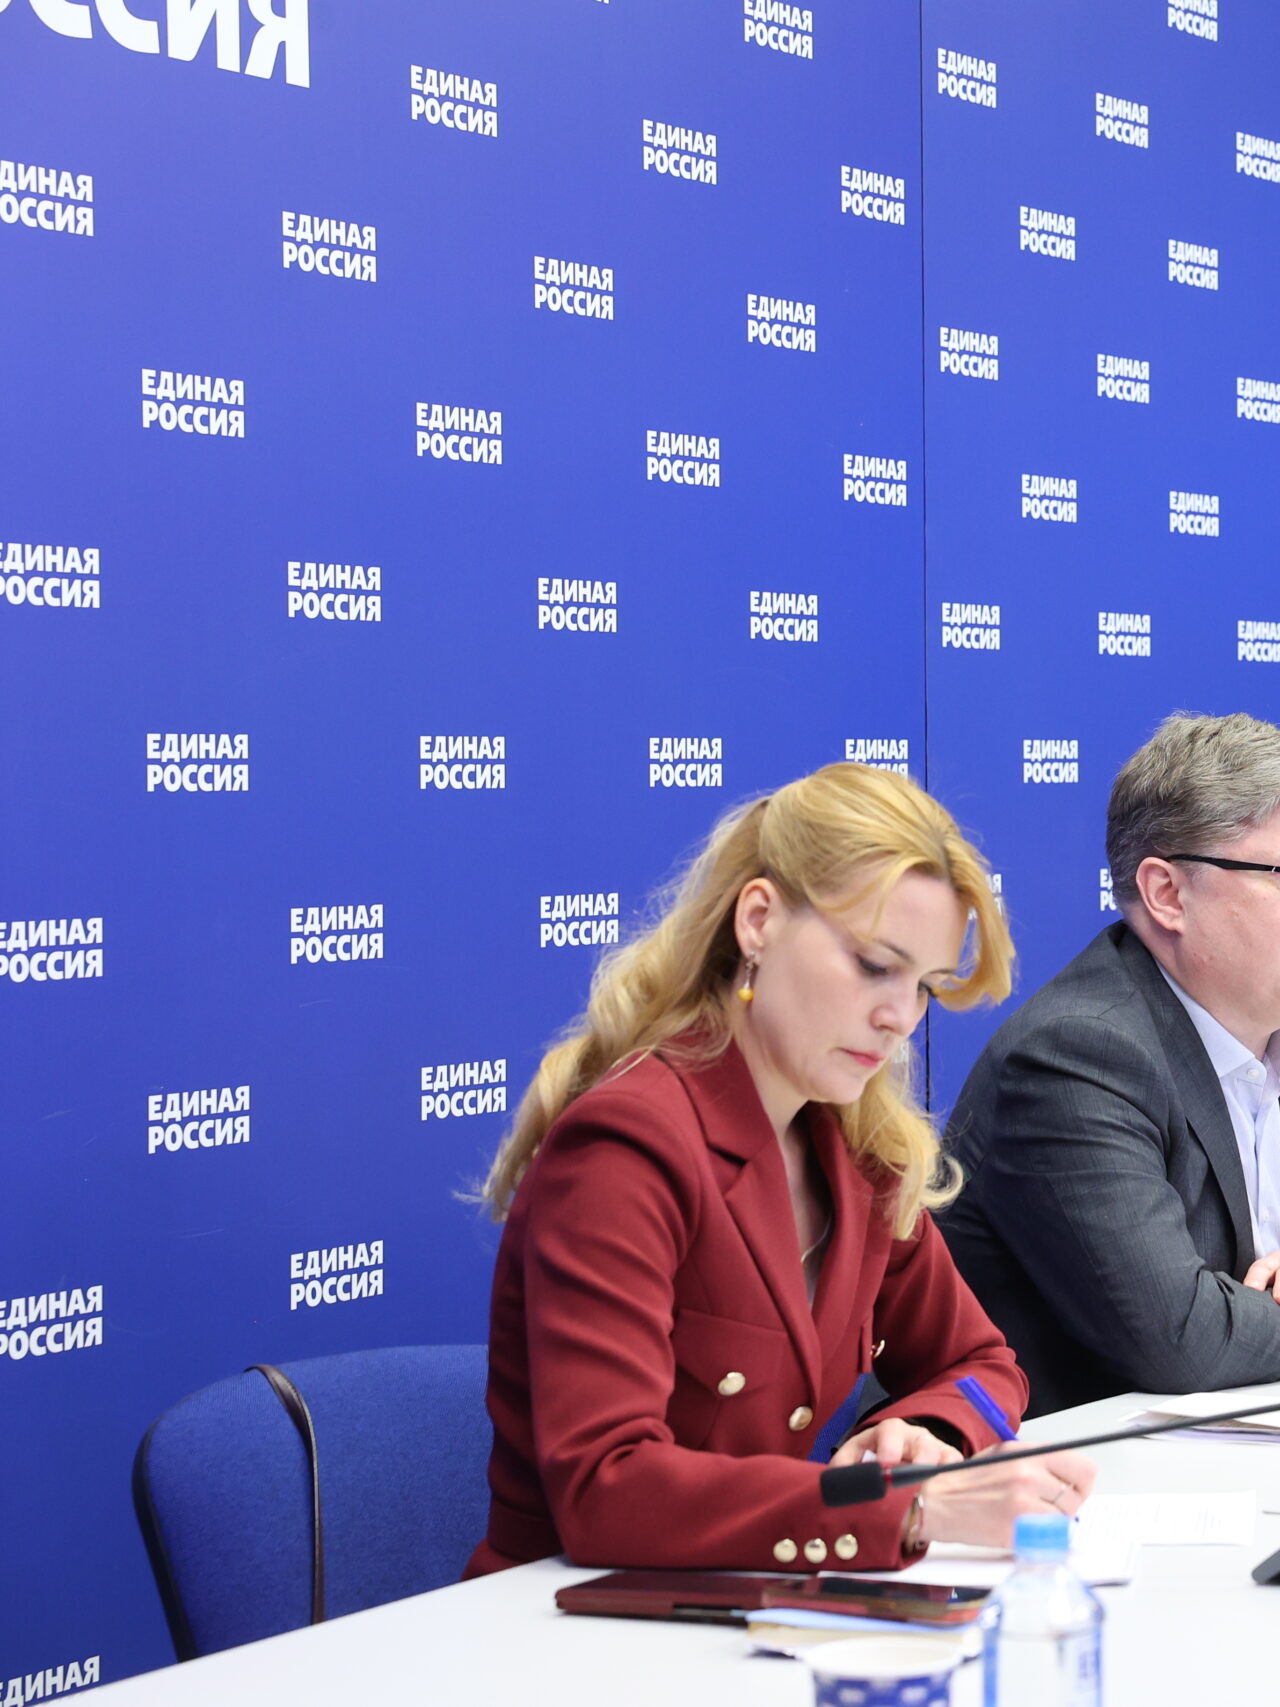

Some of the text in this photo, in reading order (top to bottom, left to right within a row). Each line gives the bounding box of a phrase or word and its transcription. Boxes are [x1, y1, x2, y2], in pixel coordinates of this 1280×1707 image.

[744, 0, 813, 33] ЕДИНАЯ
[1168, 6, 1218, 42] РОССИЯ
[744, 18, 813, 60] РОССИЯ
[938, 48, 996, 83] ЕДИНАЯ
[411, 65, 497, 107] ЕДИНАЯ
[938, 72, 996, 108] РОССИЯ
[411, 94, 497, 137] РОССИЯ
[1096, 93, 1148, 125] ЕДИНАЯ
[643, 119, 716, 157] ЕДИНАЯ
[1096, 115, 1148, 148] РОССИЯ
[644, 146, 716, 184] РОССИЯ
[0, 160, 93, 202] ДИНАЯ
[841, 166, 904, 199] ЕДИНАЯ
[0, 194, 93, 236] ОССИЯ
[842, 190, 904, 225] РОССИЯ
[1020, 206, 1075, 236] ЕДИНАЯ
[282, 211, 376, 251] ЕДИНАЯ
[1020, 229, 1075, 260] РОССИЯ
[283, 241, 376, 282] РОССИЯ
[1169, 240, 1218, 268] ЕДИНАЯ
[534, 256, 613, 291] ЕДИНАЯ
[1169, 261, 1218, 290] РОССИЯ
[535, 284, 613, 320] РОССИЯ
[748, 294, 815, 325] ЕДИНАЯ
[748, 320, 815, 352] РОССИЯ
[940, 327, 998, 355] ЕДИНАЯ
[940, 351, 998, 380] РОССИЯ
[1097, 354, 1149, 380] ЕДИНАЯ
[142, 369, 244, 405] ЕДИНАЯ
[1097, 376, 1149, 403] РОССИЯ
[142, 400, 244, 438] РОССИЯ
[416, 402, 501, 435] ЕДИНАЯ
[417, 431, 502, 464] РОССИЯ
[647, 430, 719, 459] ЕДИНАЯ
[647, 457, 719, 487] РОССИЯ
[844, 454, 906, 481] ЕДИНАЯ
[844, 478, 906, 506] РОССИЯ
[1022, 474, 1077, 499] ЕДИНАЯ
[1022, 497, 1077, 522] РОССИЯ
[1170, 491, 1219, 514] ЕДИНАЯ
[1170, 513, 1219, 536] РОССИЯ
[288, 562, 380, 590] ЕДИНАЯ
[538, 578, 616, 604] ЕДИНАЯ
[288, 591, 381, 621] РОССИЯ
[539, 605, 616, 632] РОССИЯ
[750, 591, 817, 616] ЕДИНАЯ
[942, 603, 1000, 626] ЕДИНАЯ
[751, 616, 818, 642] РОССИЯ
[942, 626, 1000, 649] РОССИЯ
[1099, 612, 1150, 634] ЕДИНАЯ
[1099, 634, 1150, 656] РОССИЯ
[147, 734, 248, 762] ЕДИНАЯ
[420, 736, 505, 762] ЕДИНАЯ
[650, 738, 722, 762] ЕДИНАЯ
[845, 738, 909, 762] ЕДИНАЯ
[1023, 740, 1078, 761] ЕДИНАЯ
[147, 764, 248, 792] РОССИЯ
[420, 764, 505, 789] РОССИЯ
[650, 764, 722, 787] РОССИЯ
[1024, 762, 1078, 783] РОССИЯ
[291, 904, 383, 935] ЕДИНАЯ
[540, 892, 619, 922] ЕДИНАЯ
[291, 933, 383, 964] РОССИЯ
[540, 919, 619, 949] РОССИЯ
[422, 1059, 506, 1092] ЕДИНАЯ
[149, 1086, 249, 1123] ЕДИНАЯ
[421, 1087, 506, 1120] РОССИЯ
[149, 1116, 249, 1154] РОССИЯ
[291, 1240, 383, 1280] ЕДИНАЯ
[291, 1269, 383, 1310] РОССИЯ
[0, 1655, 100, 1707] ДИНАЯ
